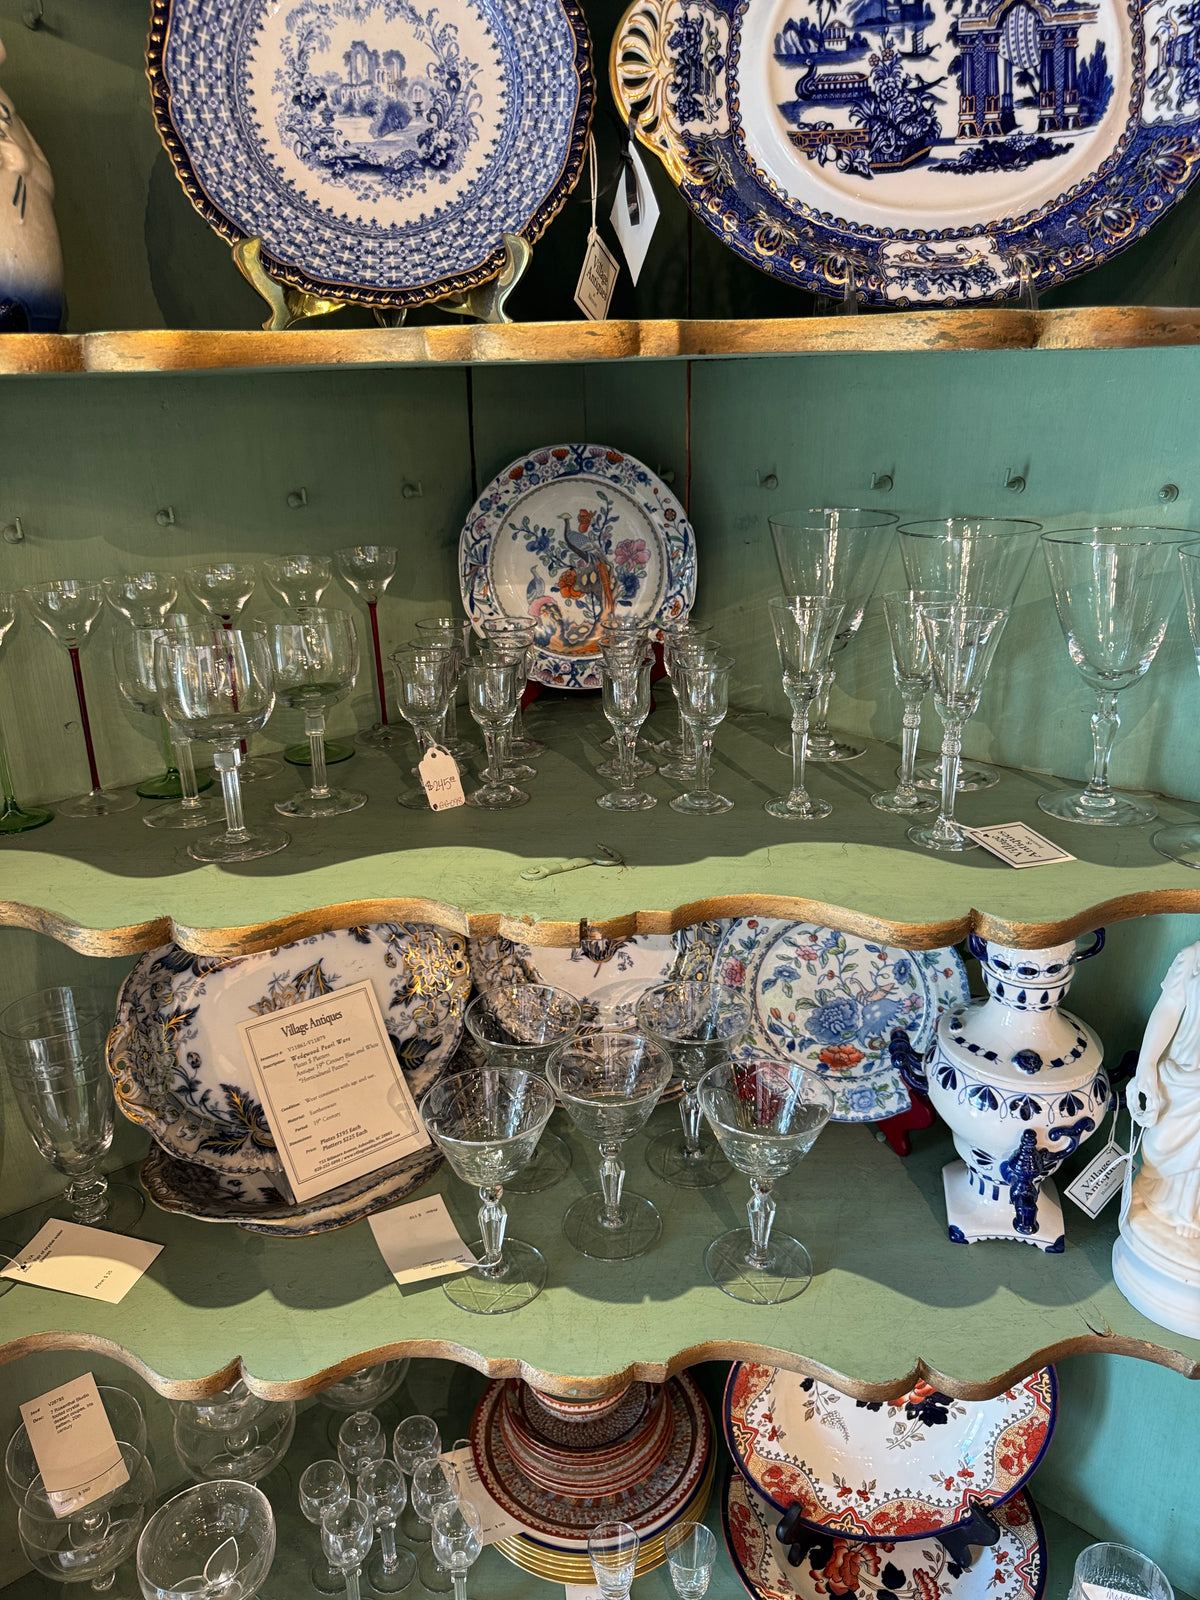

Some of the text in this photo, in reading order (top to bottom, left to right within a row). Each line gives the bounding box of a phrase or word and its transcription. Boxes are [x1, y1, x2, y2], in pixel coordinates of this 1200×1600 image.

[991, 835, 1022, 857] Village
[997, 830, 1042, 858] Antiques
[280, 1011, 342, 1037] Village Antiques
[290, 1047, 320, 1061] Wedgwood
[321, 1041, 335, 1051] Pearl
[1081, 1160, 1112, 1190] Village
